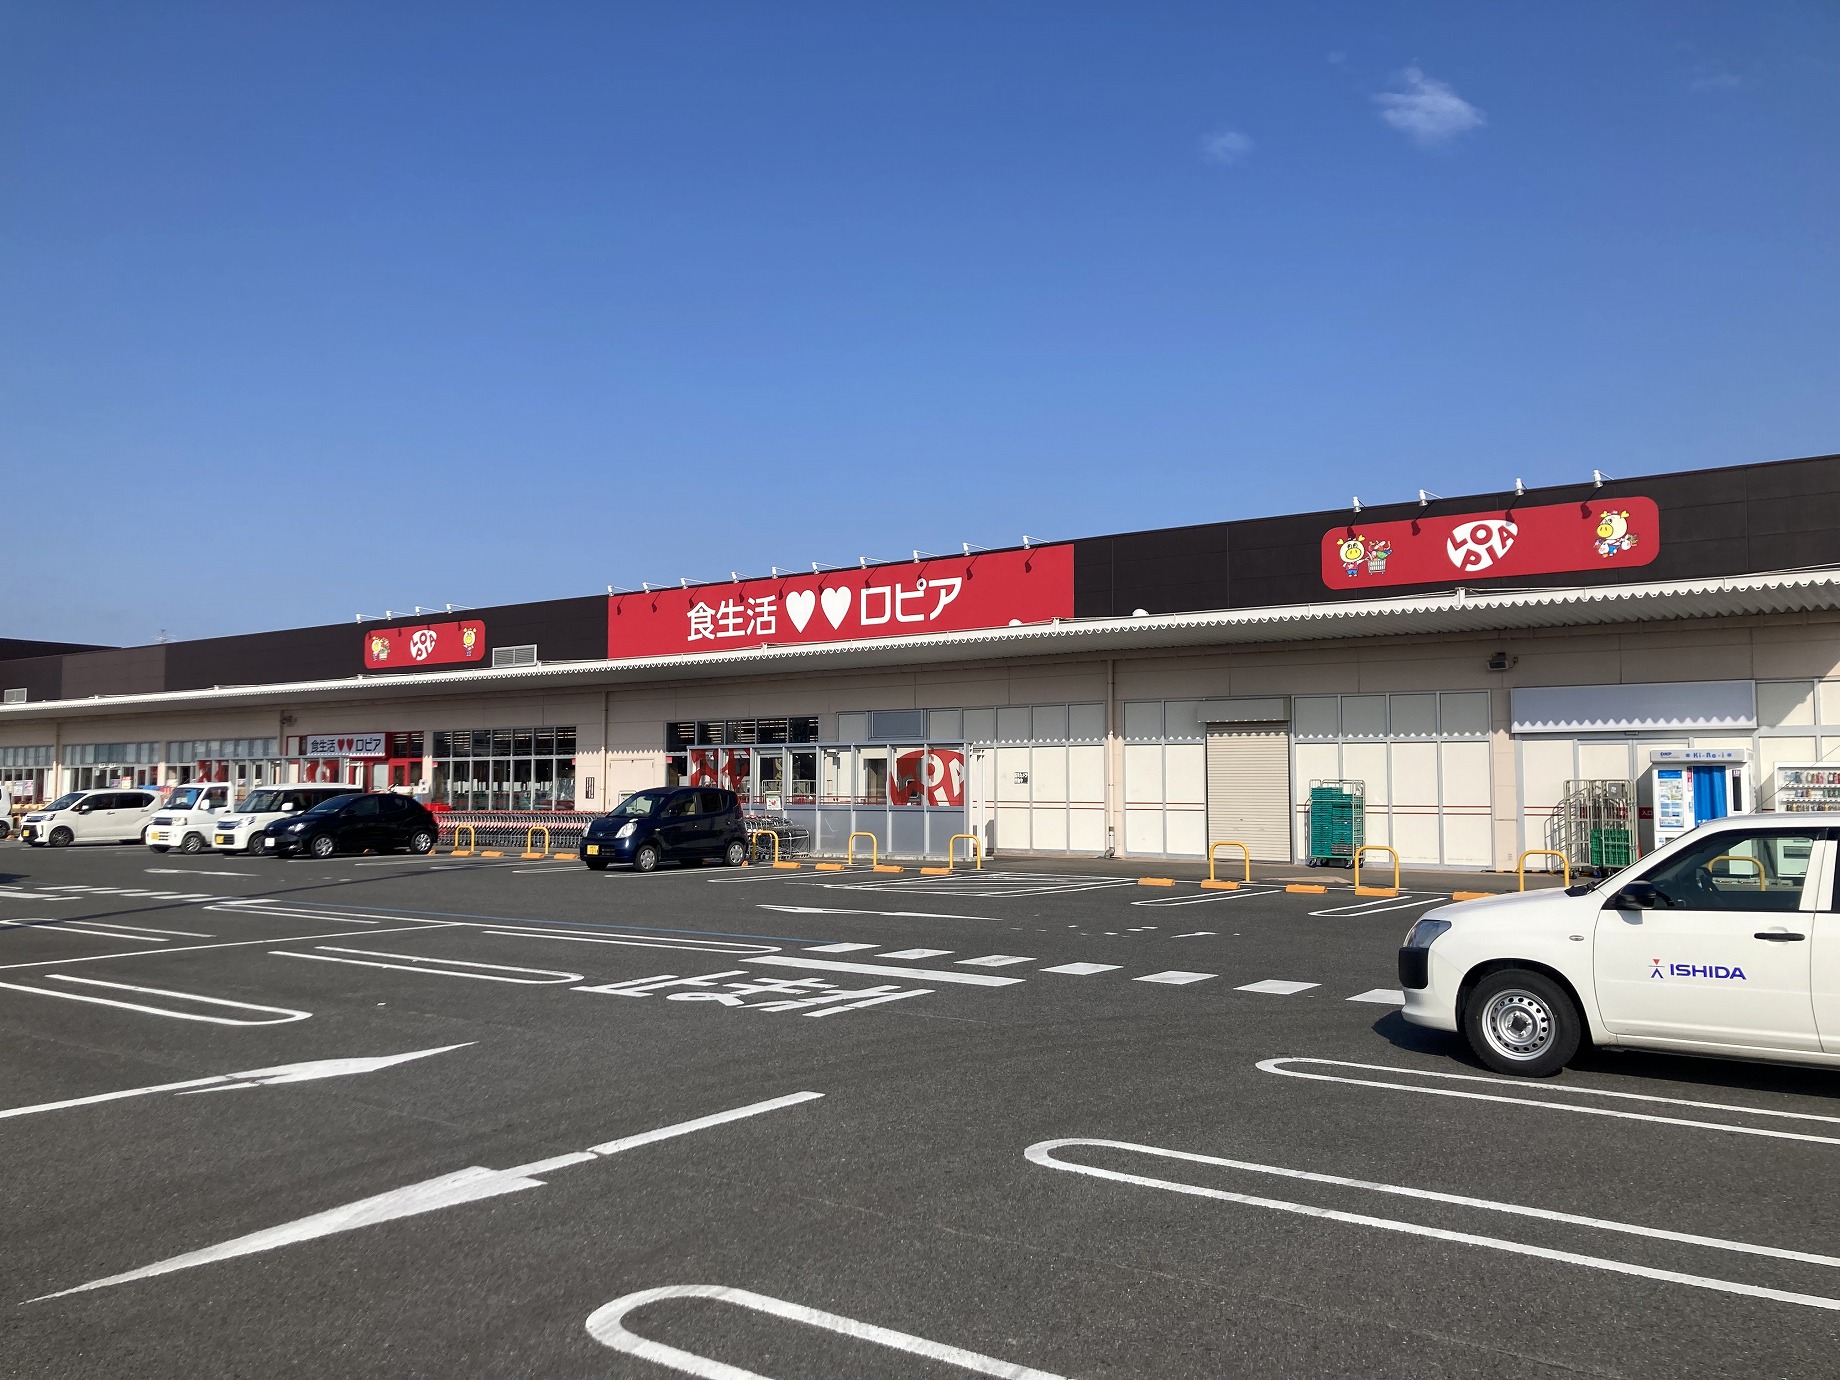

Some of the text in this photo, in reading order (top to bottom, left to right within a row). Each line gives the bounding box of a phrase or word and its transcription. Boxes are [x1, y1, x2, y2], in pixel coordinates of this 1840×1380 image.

[1447, 523, 1517, 571] LOPIA
[686, 576, 963, 642] 食生活 ロピア
[410, 631, 437, 660] LOPIA
[311, 737, 382, 753] 食生活 ロピア
[1669, 963, 1747, 980] ISHIDA
[569, 970, 936, 1018] 止まれ
